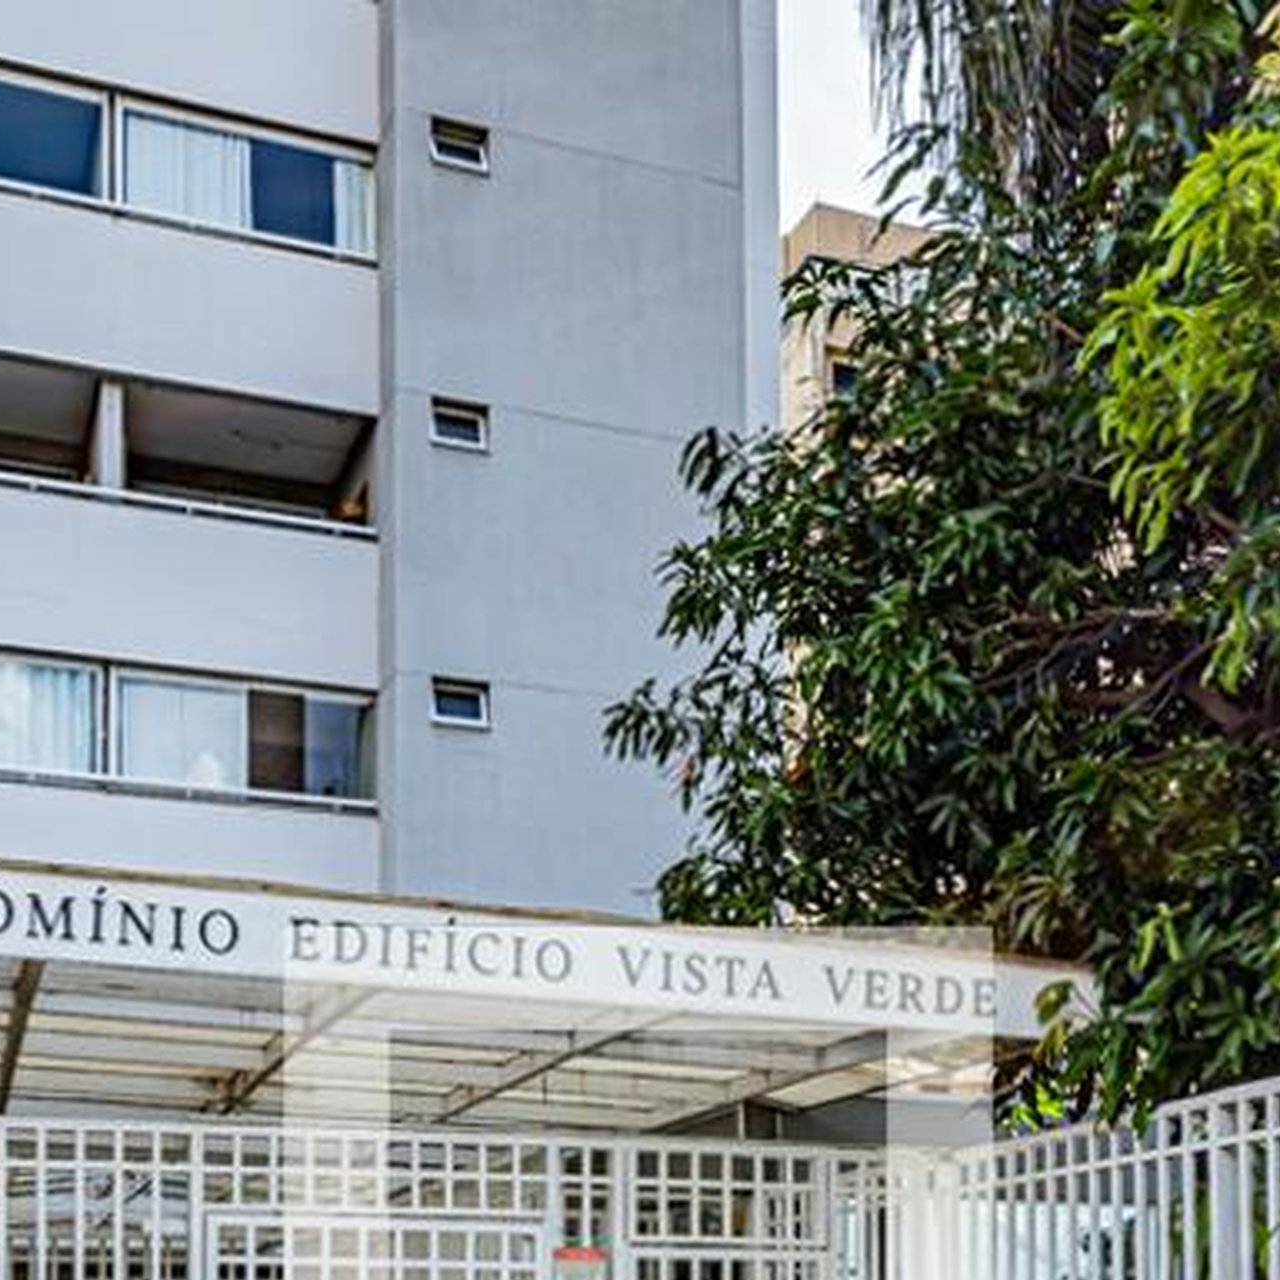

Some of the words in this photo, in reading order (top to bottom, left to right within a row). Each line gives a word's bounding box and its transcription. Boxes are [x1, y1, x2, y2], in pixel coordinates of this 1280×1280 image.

[289, 916, 574, 983] EDIFÍCIO
[615, 945, 782, 1000] VISTA
[823, 966, 1000, 1017] VERDE
